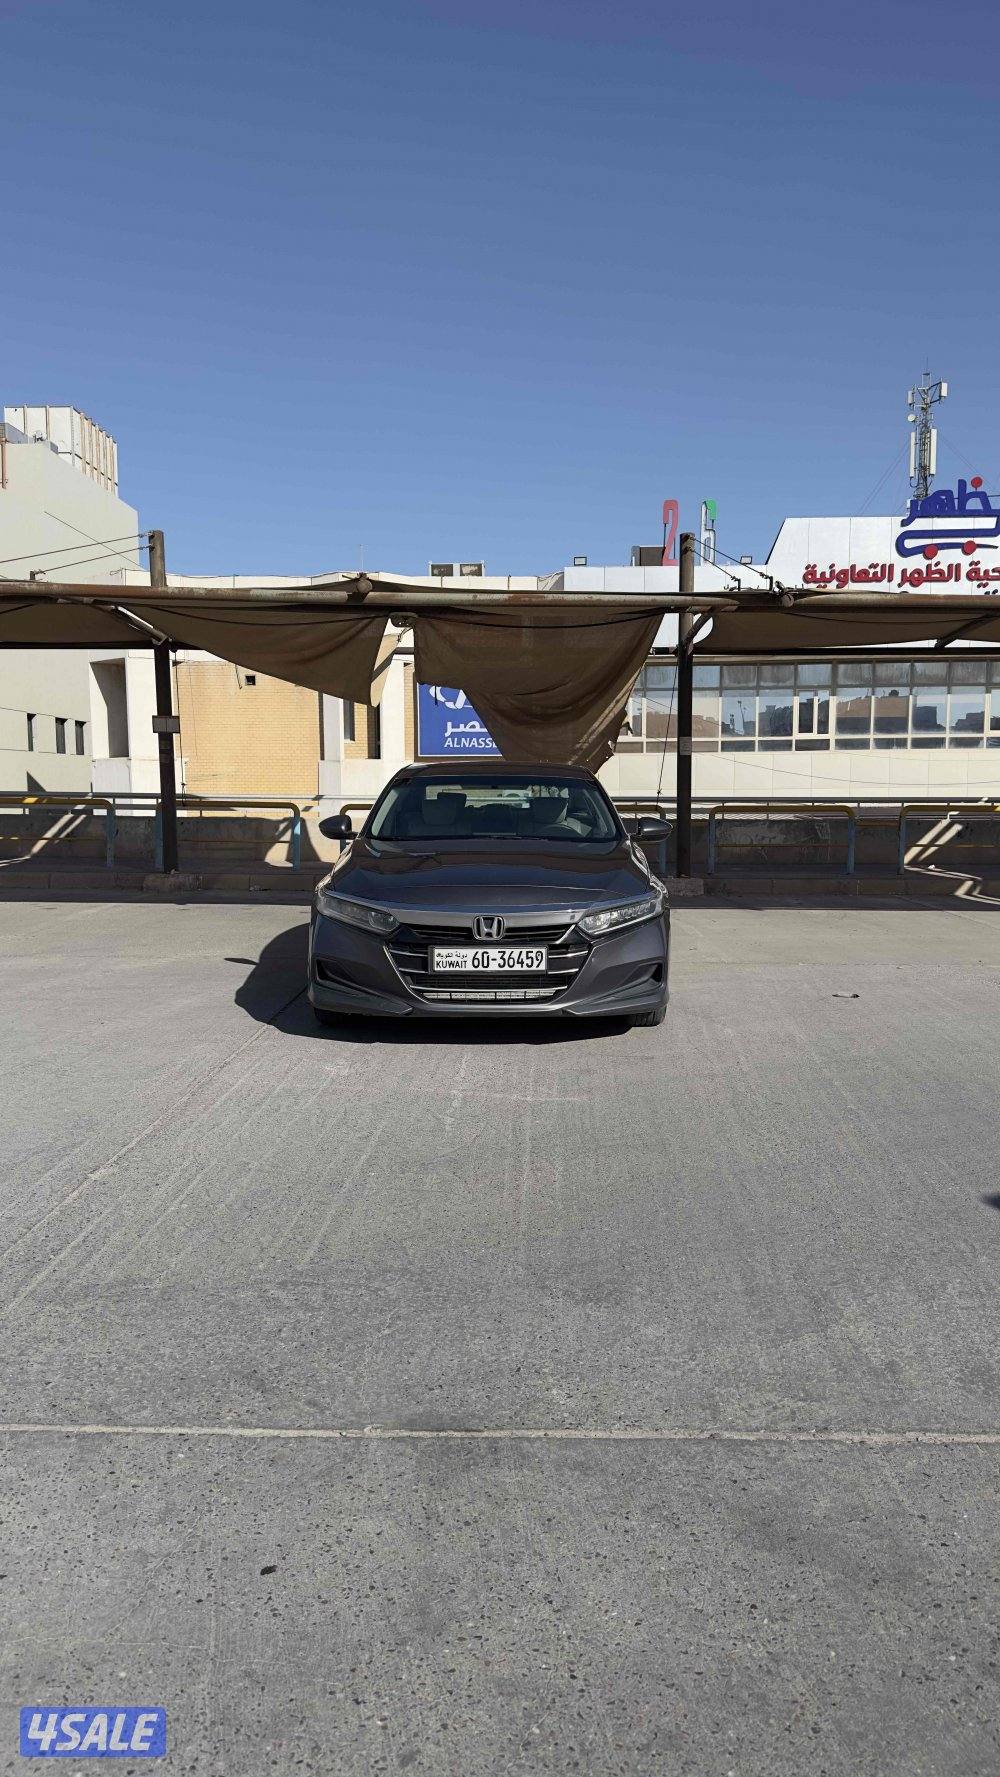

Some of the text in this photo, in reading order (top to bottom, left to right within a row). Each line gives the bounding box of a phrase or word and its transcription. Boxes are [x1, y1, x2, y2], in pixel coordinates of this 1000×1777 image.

[802, 562, 894, 589] التعاونية
[897, 561, 961, 588] الظهر
[444, 720, 489, 738] صر
[436, 960, 468, 969] KUWAIT
[472, 950, 544, 969] 60-36459
